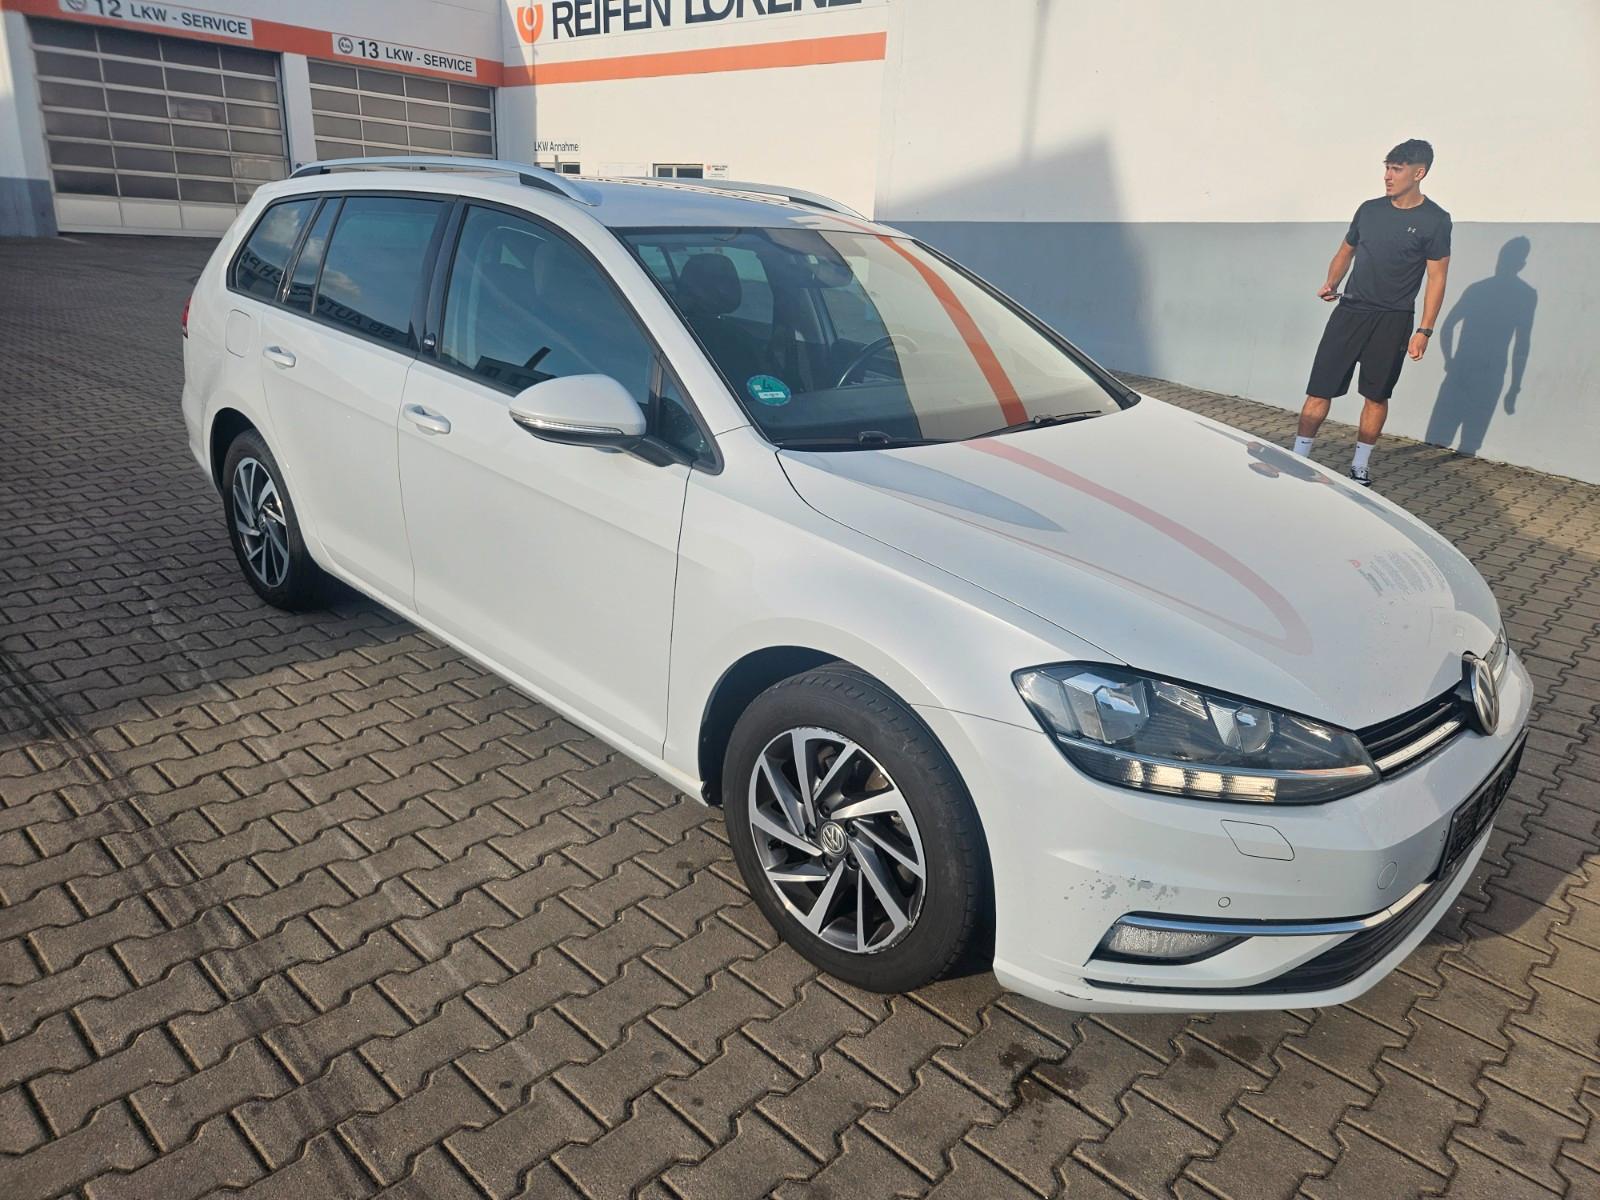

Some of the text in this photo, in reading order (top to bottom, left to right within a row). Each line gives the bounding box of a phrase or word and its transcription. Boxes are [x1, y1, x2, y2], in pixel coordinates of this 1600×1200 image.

[96, 0, 123, 18] 12
[130, 3, 167, 22] LKW
[181, 12, 248, 35] SERVICE
[552, 0, 671, 39] REIFEN
[358, 40, 380, 59] 13
[385, 47, 414, 62] LKW
[424, 54, 472, 72] SERVICE
[534, 140, 579, 152] LKW Annahme
